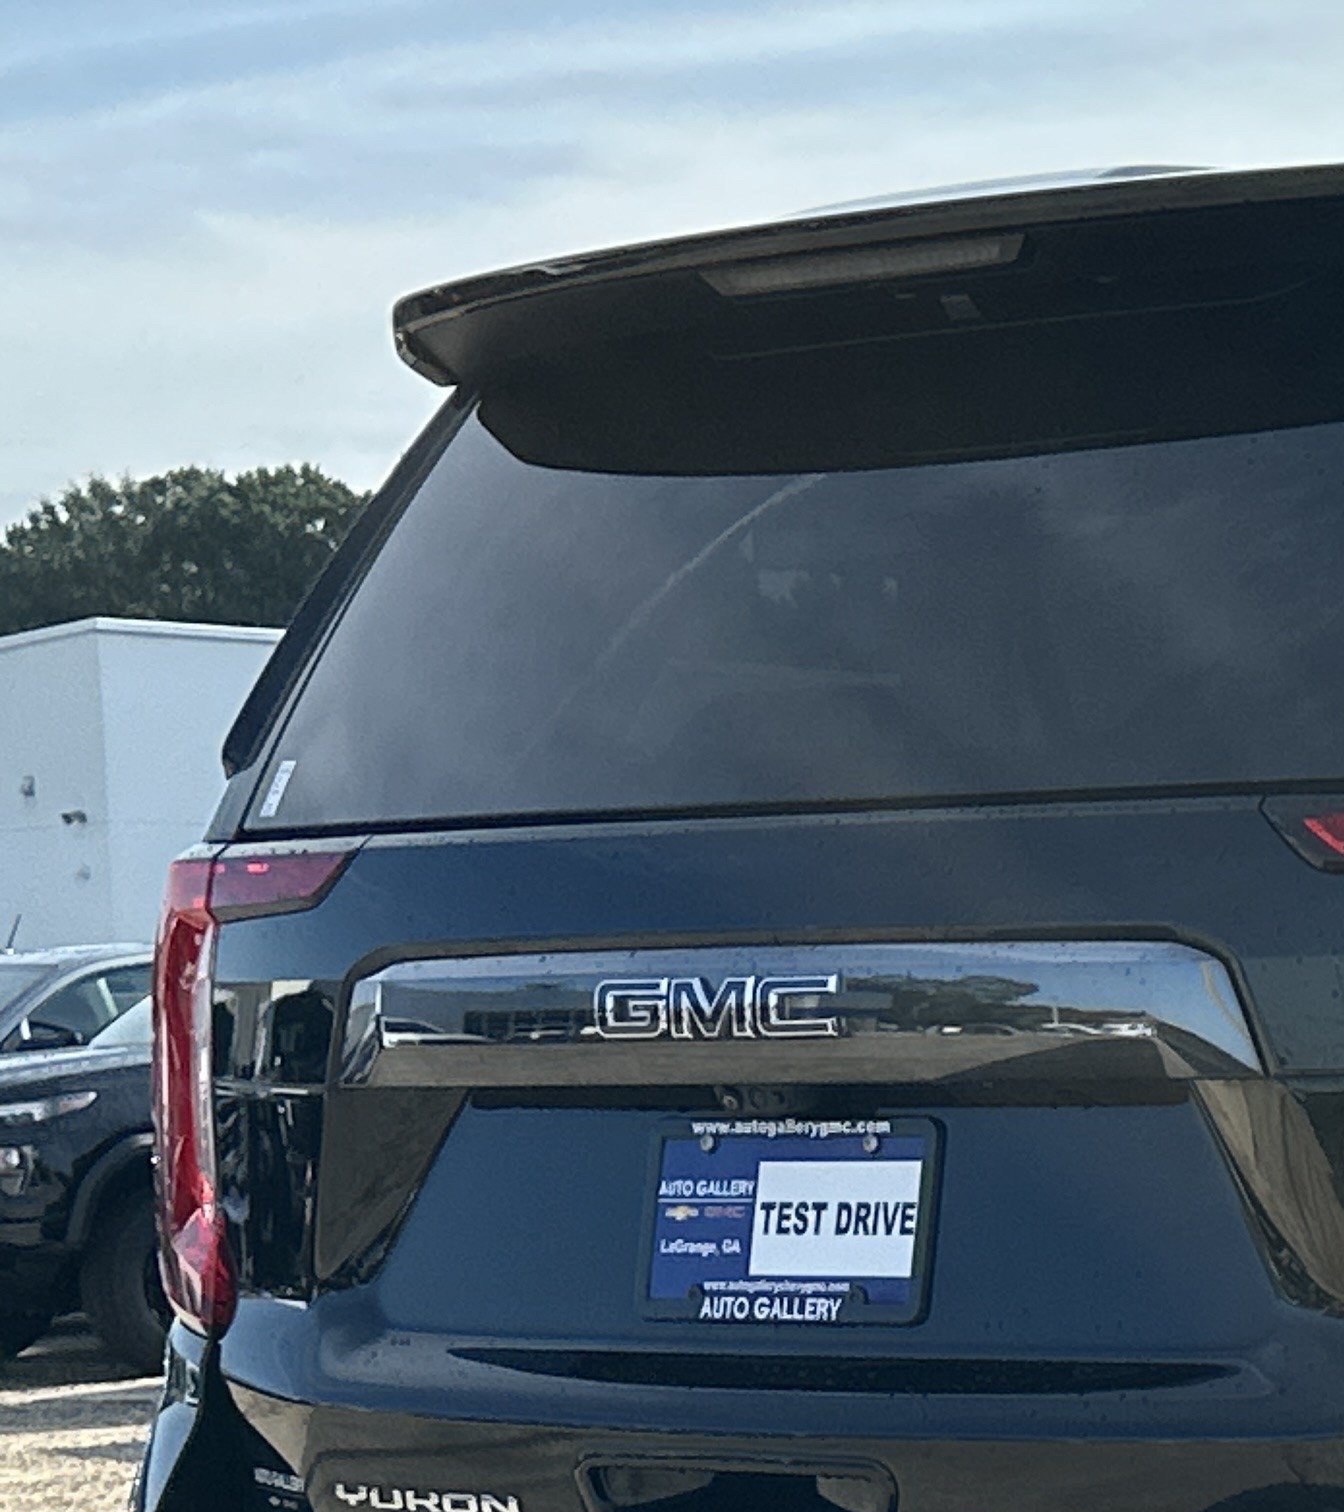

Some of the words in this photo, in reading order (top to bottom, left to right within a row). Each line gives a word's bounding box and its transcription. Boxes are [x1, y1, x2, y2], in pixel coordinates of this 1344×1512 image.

[594, 973, 839, 1040] GMC
[691, 1118, 891, 1138] www.autogallerygmc.com
[659, 1179, 694, 1197] AUTO
[696, 1179, 755, 1197] GALLERY
[760, 1201, 827, 1236] TEST
[835, 1201, 917, 1236] DRIVE
[700, 1296, 750, 1320] AUTO
[754, 1296, 843, 1321] GALLERY
